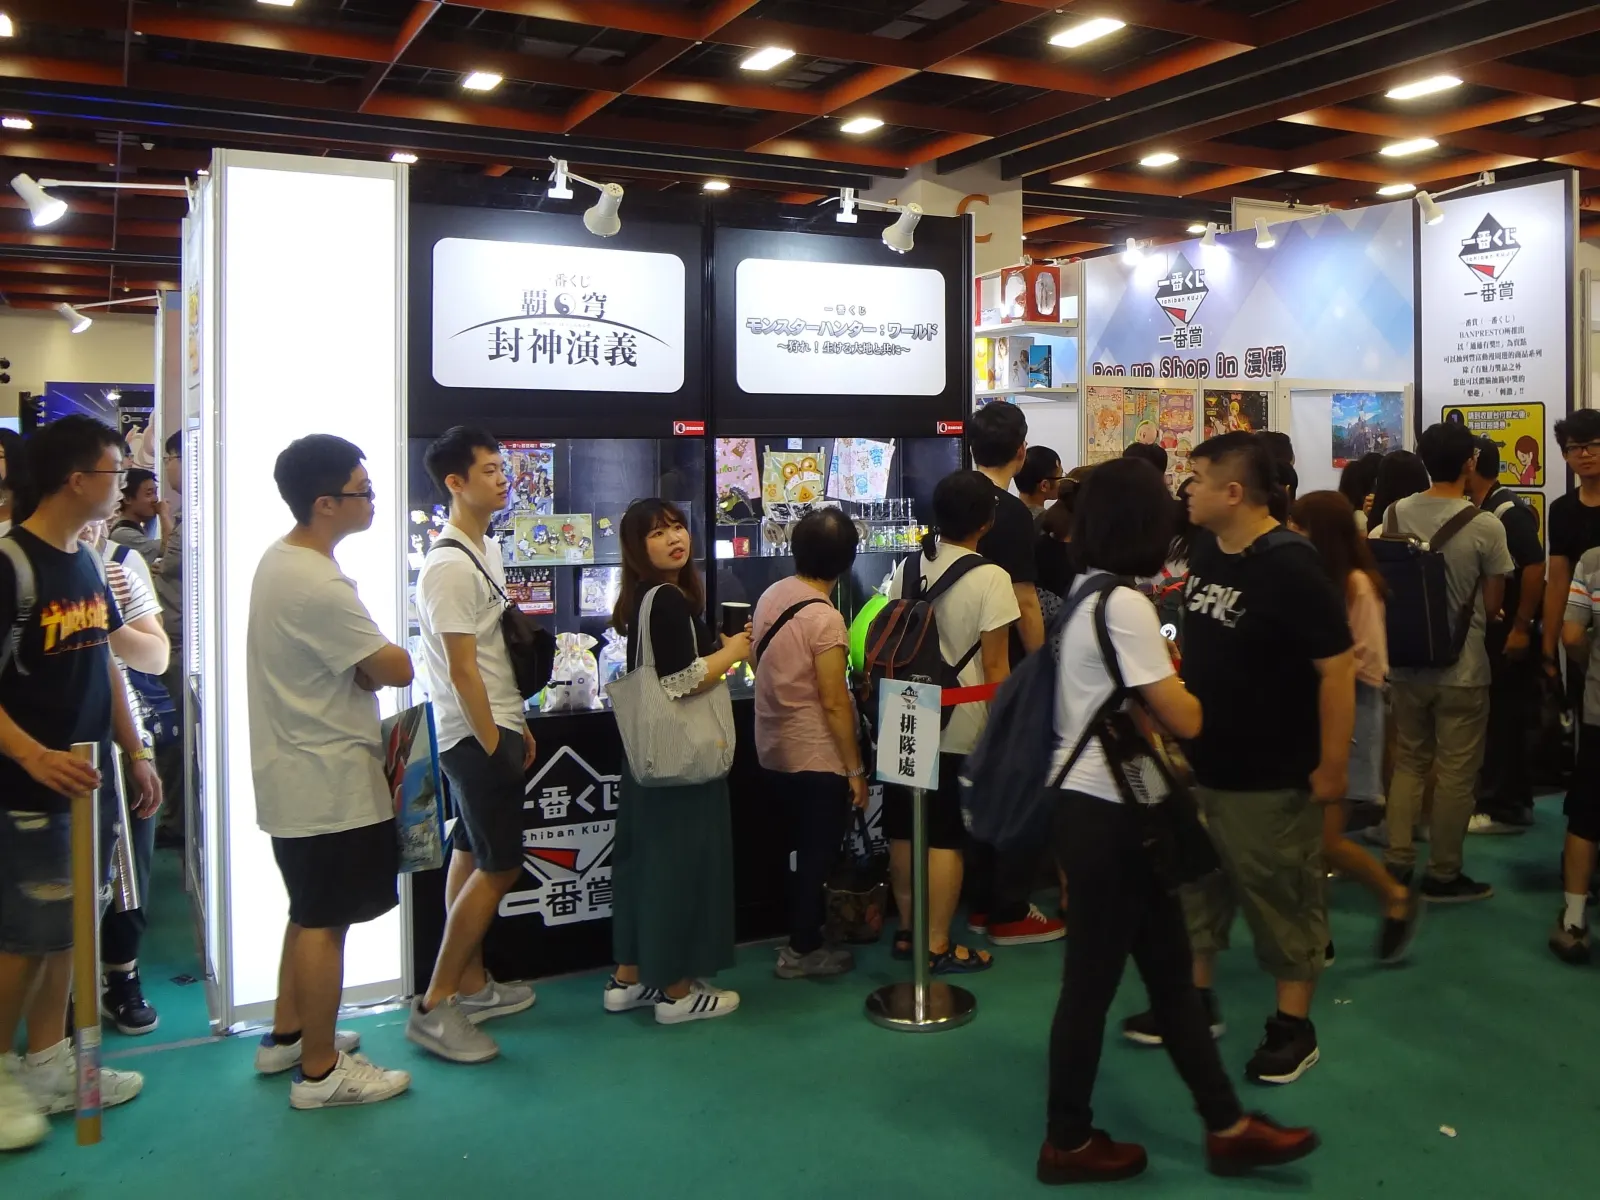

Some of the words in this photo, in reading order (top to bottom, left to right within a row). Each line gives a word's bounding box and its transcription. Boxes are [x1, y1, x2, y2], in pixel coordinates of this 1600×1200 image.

[1461, 227, 1517, 250] 一番くじ
[547, 273, 591, 288] 番くじ
[1158, 269, 1205, 291] 一番くじ
[1464, 280, 1514, 302] 一番賞
[824, 304, 866, 316] 一番くじ
[488, 326, 637, 367] 封神演義
[1159, 326, 1203, 349] 一番賞
[1160, 356, 1210, 379] Shop
[1216, 352, 1238, 378] in
[1245, 346, 1286, 378] 漫博
[898, 713, 917, 777] 排隊處
[522, 829, 575, 843] chiban
[581, 823, 611, 836] KUJ
[506, 875, 613, 917] 一番賞
